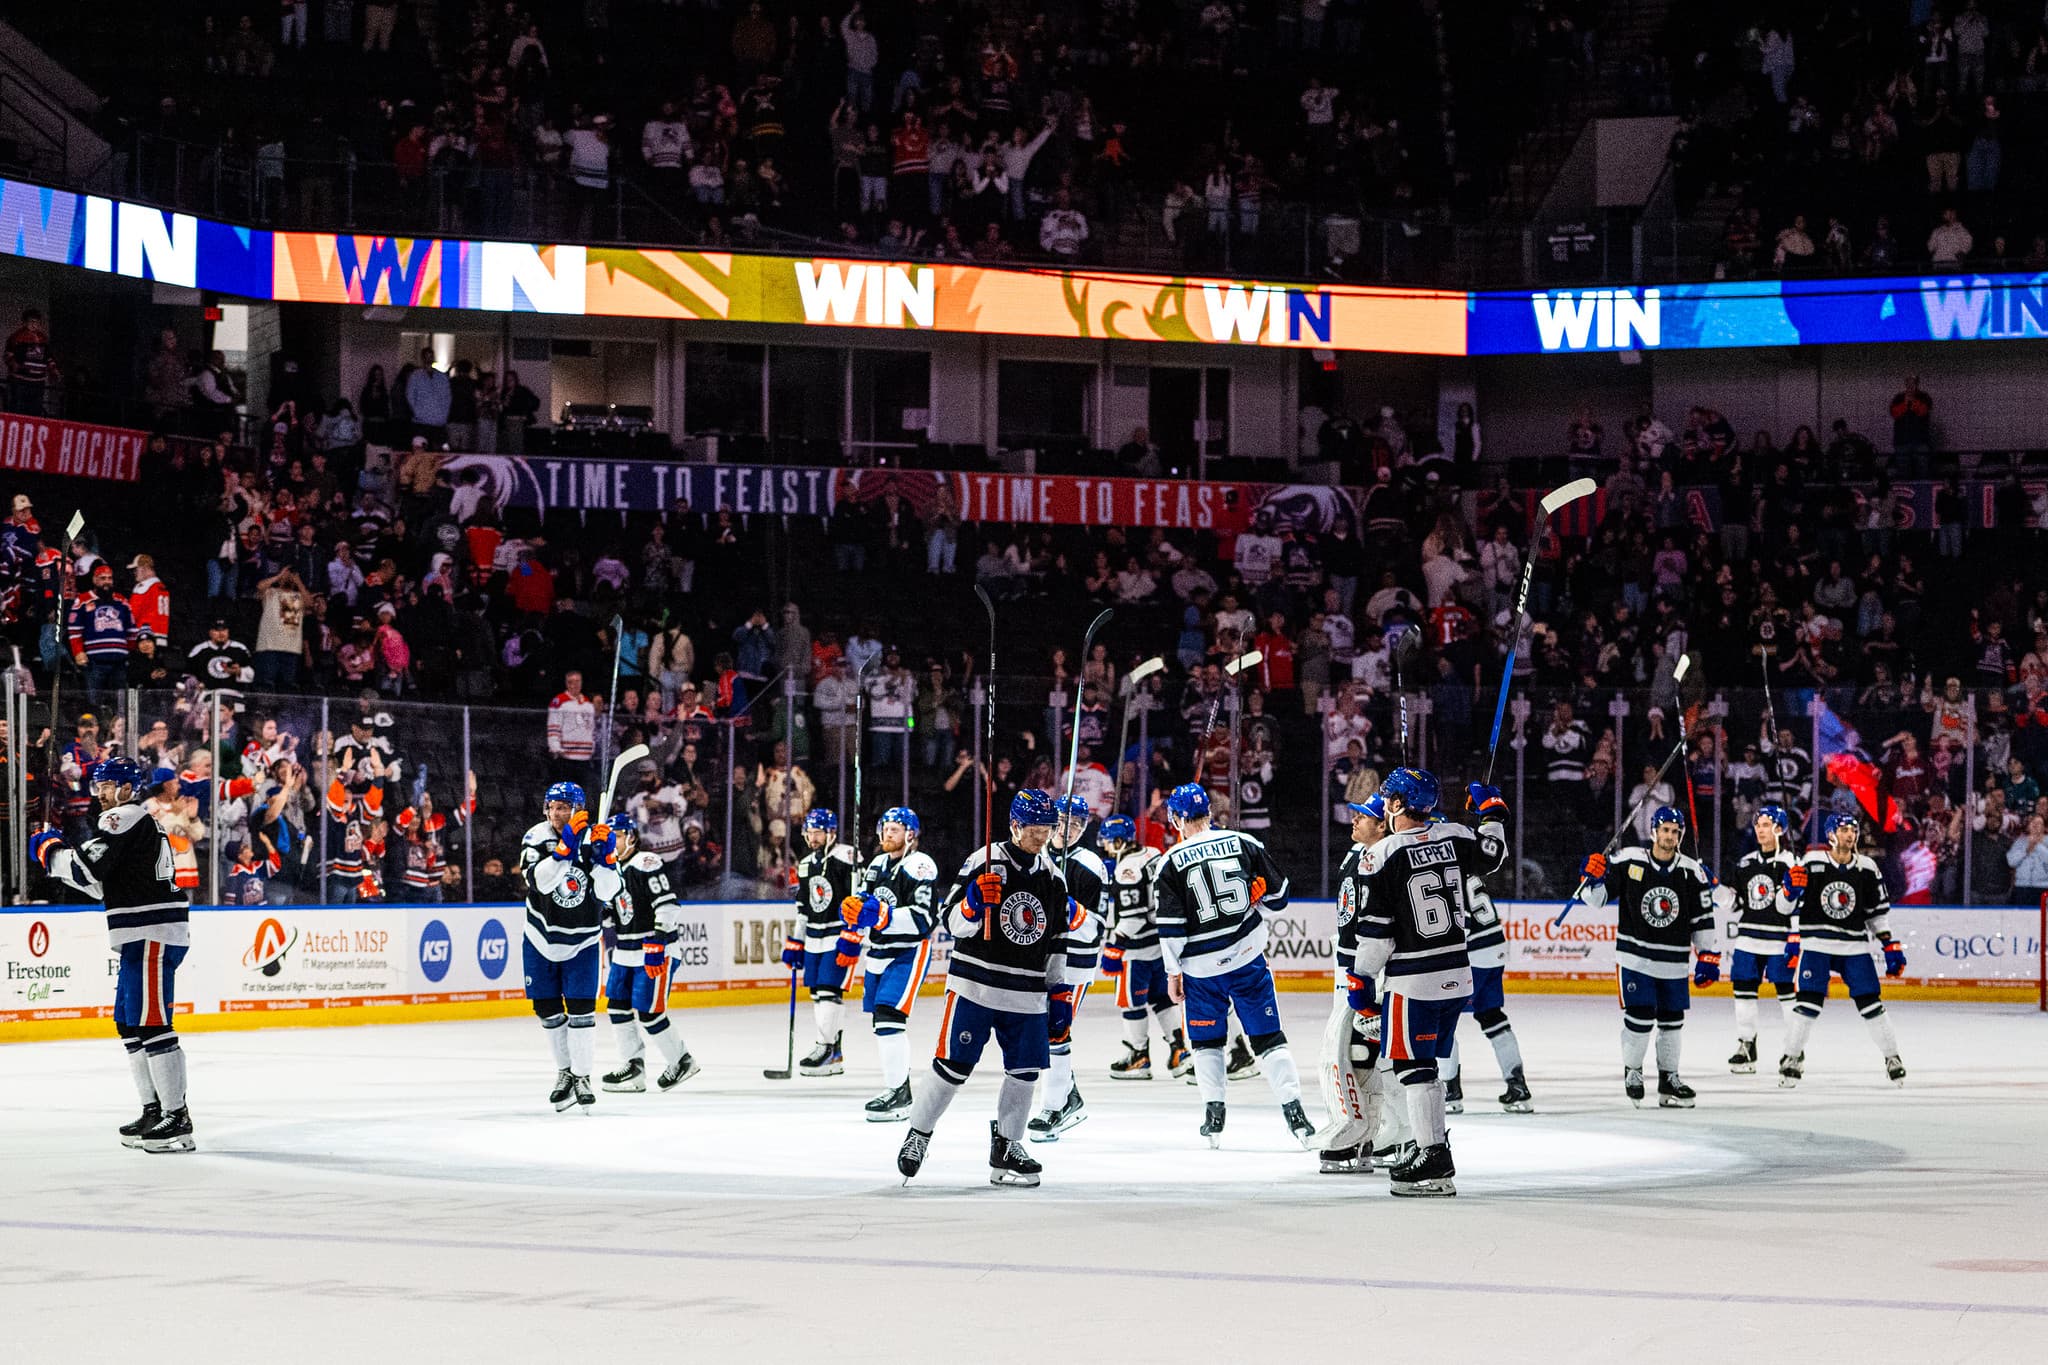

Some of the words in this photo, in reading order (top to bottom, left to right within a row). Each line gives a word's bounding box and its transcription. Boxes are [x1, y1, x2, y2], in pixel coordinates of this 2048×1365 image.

[794, 262, 934, 327] WIN
[1202, 282, 1331, 342] WIN
[1532, 289, 1660, 349] WIN
[58, 428, 142, 480] HOCKEY
[546, 462, 629, 508] TIME
[652, 465, 692, 509] TO
[715, 467, 821, 514] FEAST
[977, 476, 1053, 522] TIME
[1076, 481, 1113, 525] TO
[1517, 562, 1532, 615] CCM
[1176, 838, 1239, 868] JARVENTIE
[1411, 845, 1455, 867] KEPPEN
[1001, 892, 1046, 923] BAKERSFIELD
[1119, 889, 1141, 906] 53
[1187, 858, 1250, 923] 15
[1406, 866, 1466, 938] 63
[304, 929, 349, 953] Atech
[355, 931, 389, 953] MSP
[1002, 923, 1042, 944] CONDORS
[1935, 934, 2005, 960] CBCC
[8, 961, 71, 979] Firestone
[302, 959, 311, 969] IT
[311, 960, 355, 972] Management
[357, 959, 388, 969] Solutions
[28, 982, 50, 1001] Grill
[1345, 1073, 1363, 1120] CCM
